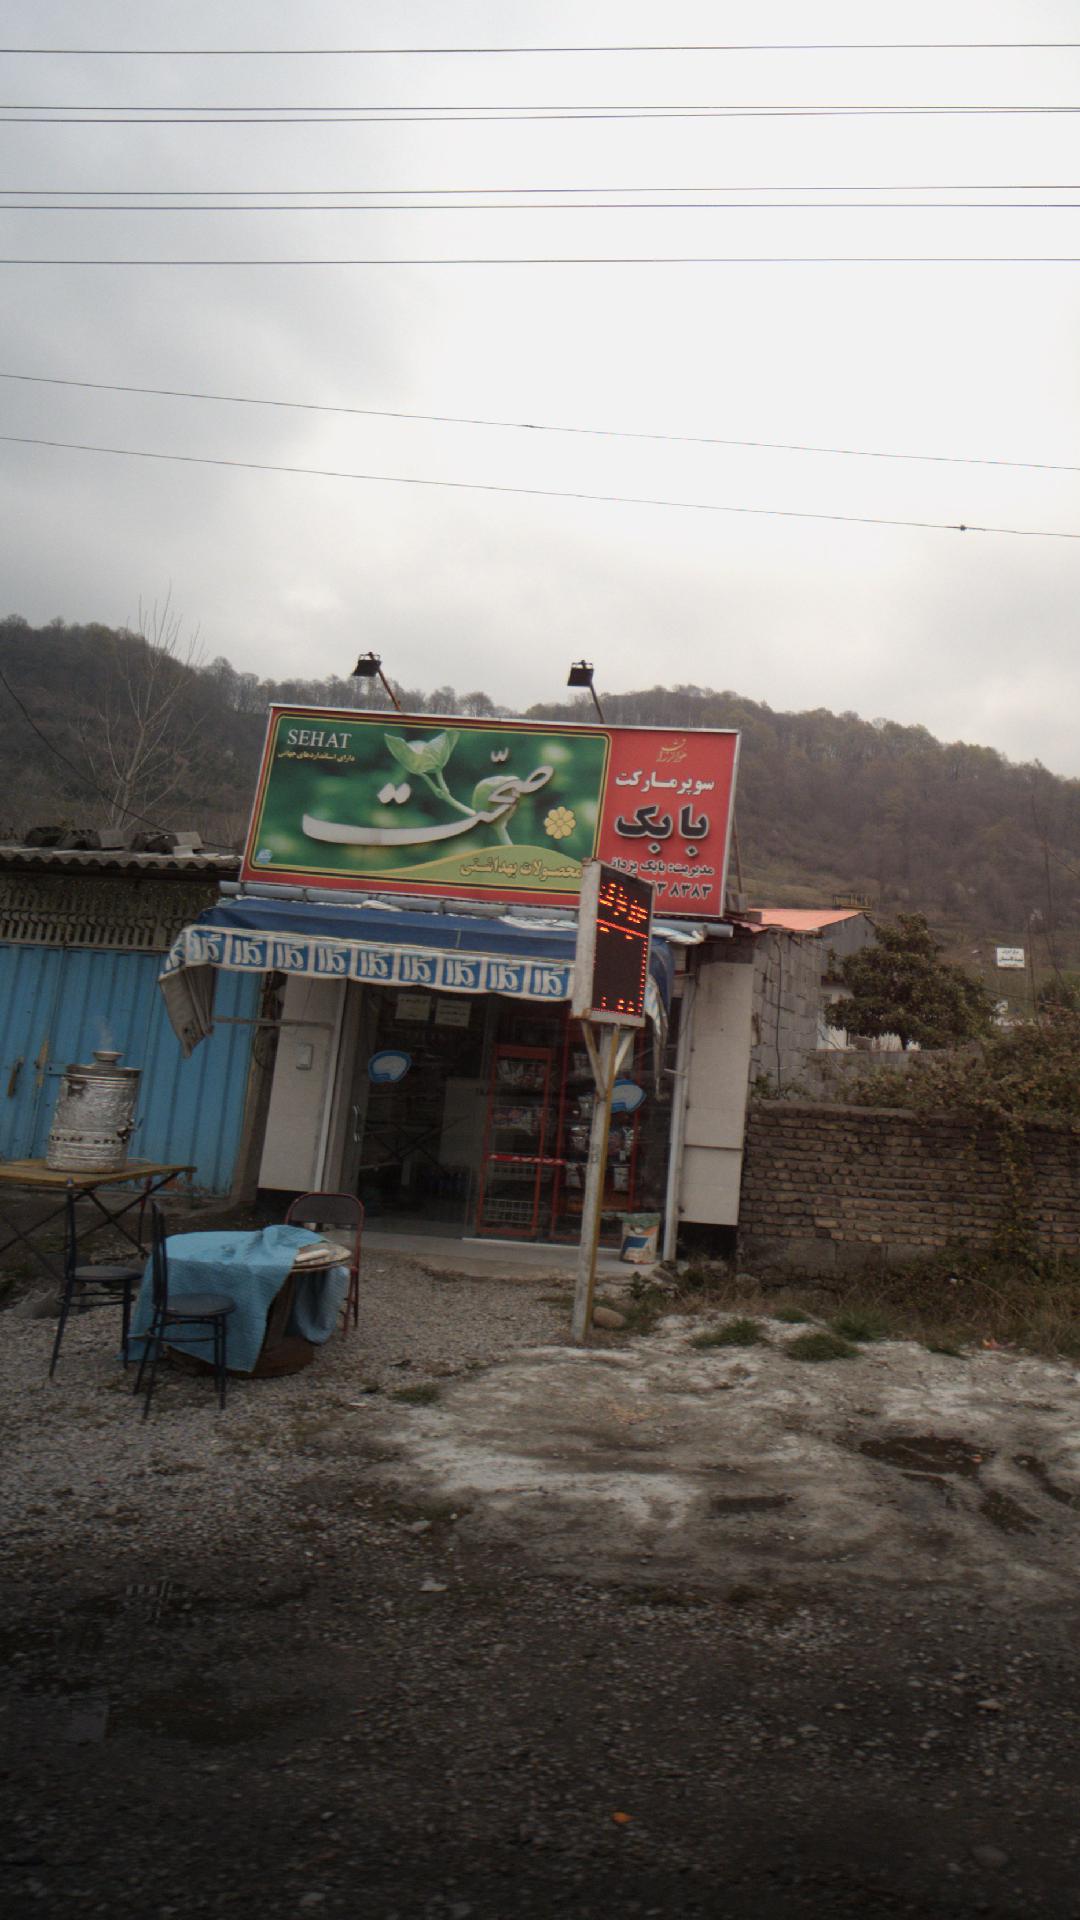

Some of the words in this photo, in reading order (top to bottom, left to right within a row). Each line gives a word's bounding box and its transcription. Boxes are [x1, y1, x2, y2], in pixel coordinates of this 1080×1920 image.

[287, 728, 353, 749] SEHAT
[614, 803, 709, 857] بابک
[459, 855, 518, 878] بهداشتی
[519, 858, 583, 881] محصولات
[640, 859, 666, 874] بابک
